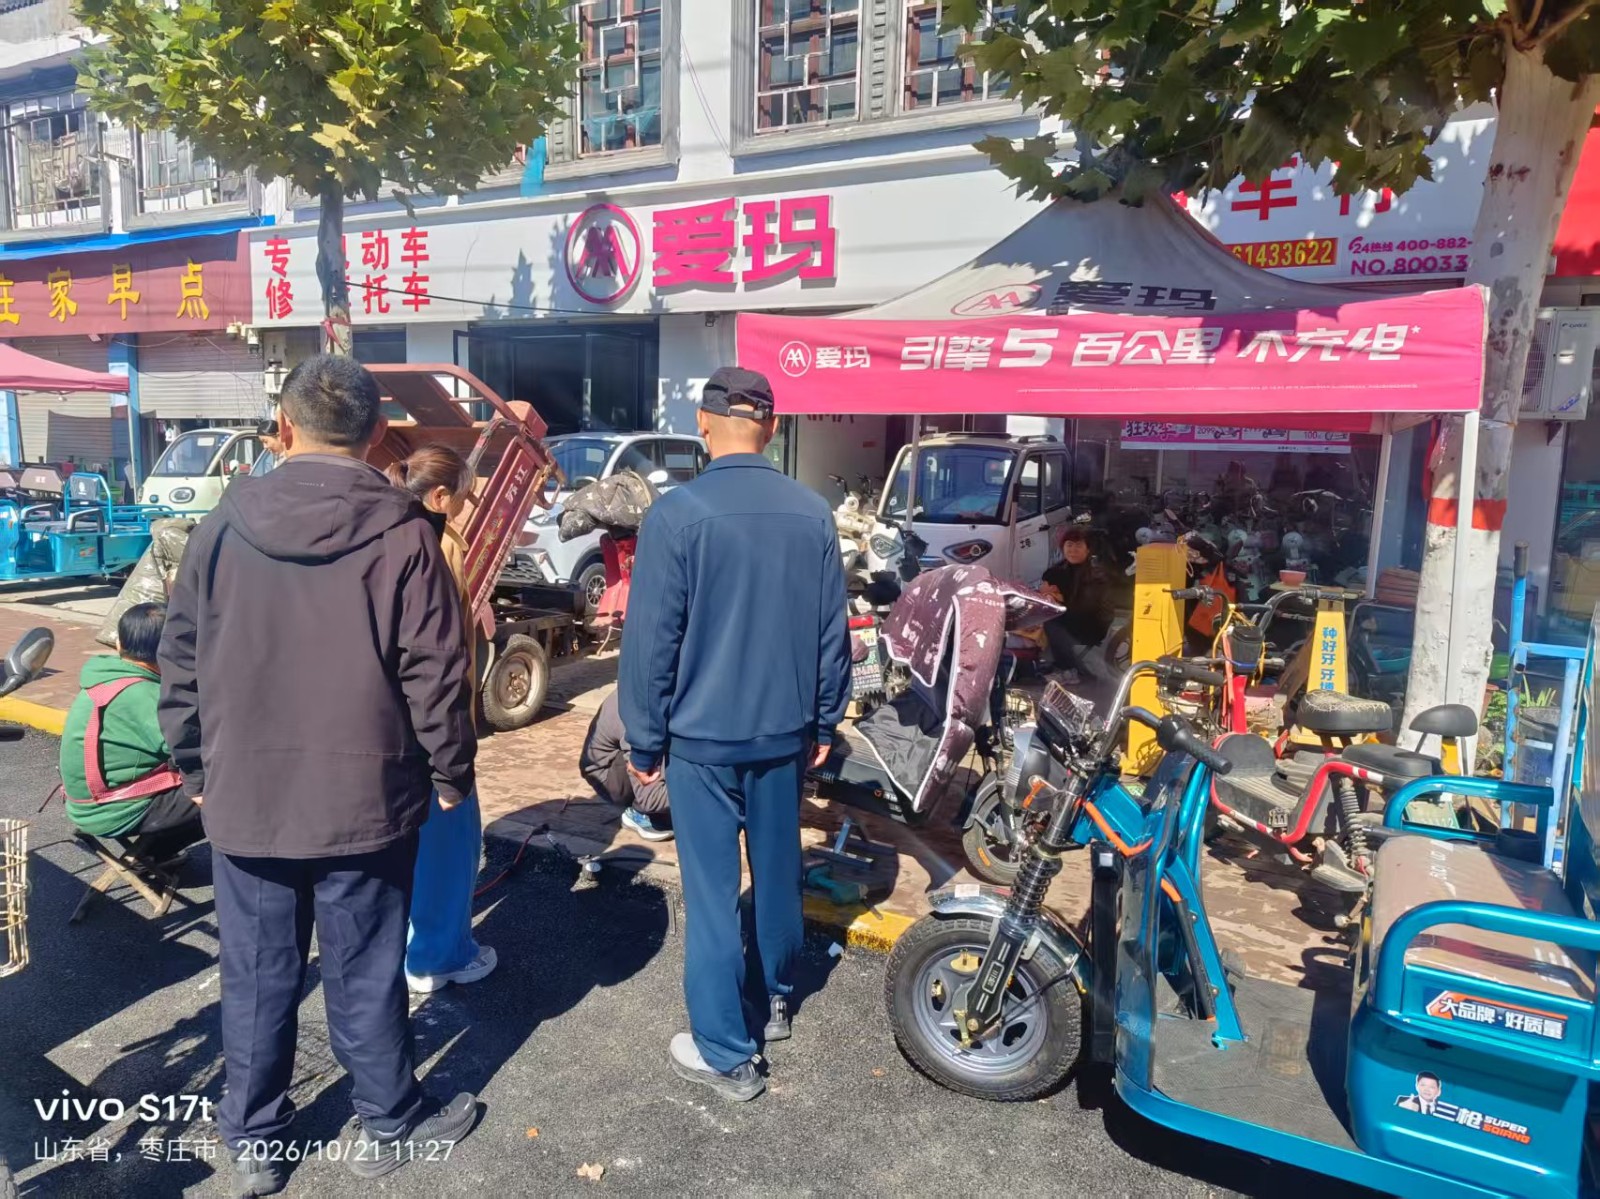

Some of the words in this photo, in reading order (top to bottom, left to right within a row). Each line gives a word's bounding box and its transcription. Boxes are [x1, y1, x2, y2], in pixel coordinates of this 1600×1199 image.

[341, 226, 429, 270] 动车
[653, 195, 836, 287] 爱玛
[264, 234, 293, 319] 专修
[344, 271, 430, 315] 托车
[815, 345, 871, 369] 爱玛
[1432, 1100, 1483, 1129] 三枪
[1484, 1115, 1528, 1134] SUPER
